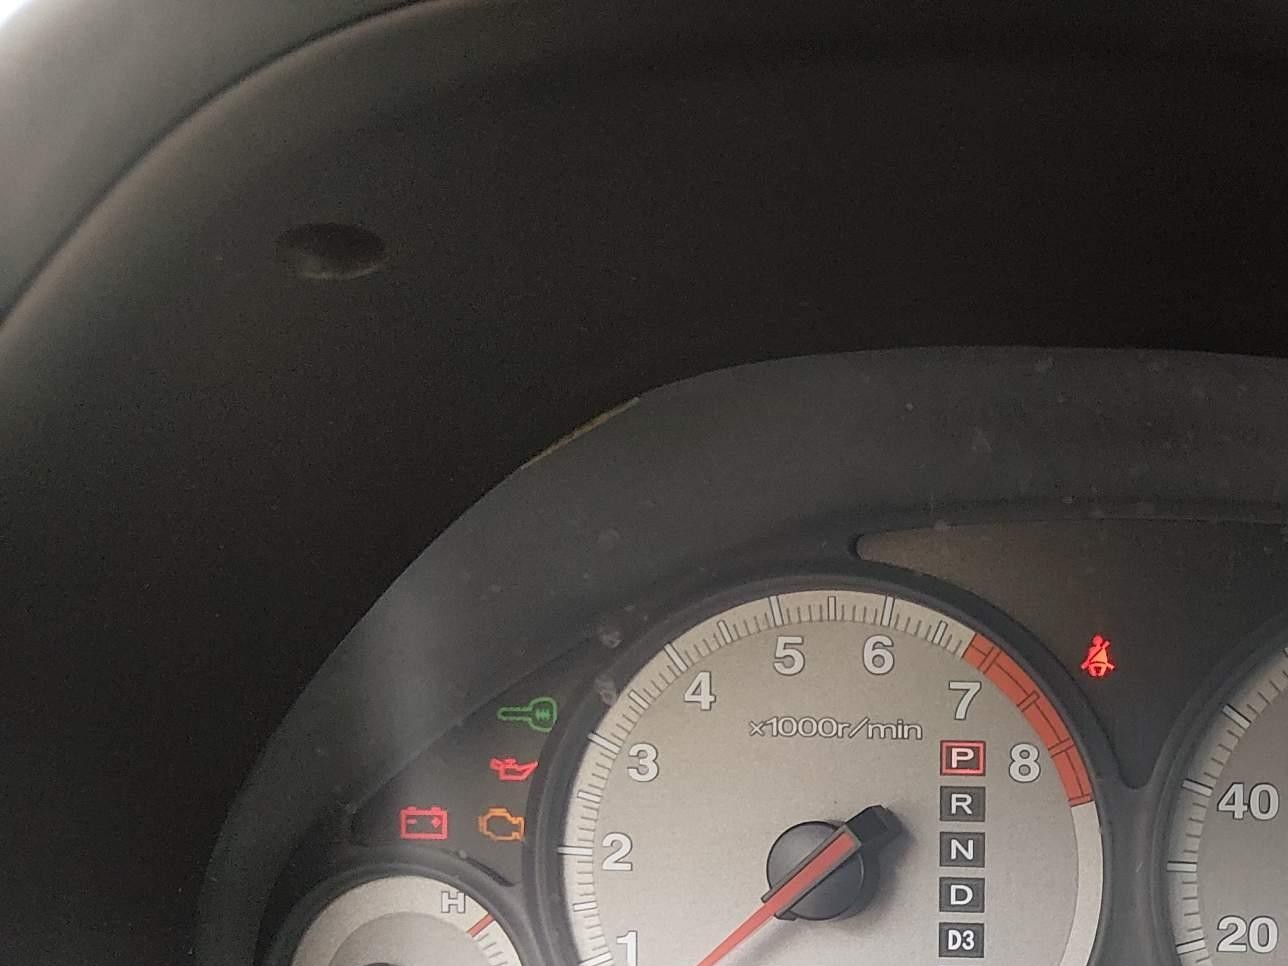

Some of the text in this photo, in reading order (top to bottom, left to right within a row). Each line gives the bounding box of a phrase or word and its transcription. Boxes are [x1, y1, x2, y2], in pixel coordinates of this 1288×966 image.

[773, 636, 805, 675] 5
[862, 635, 895, 674] 6
[684, 672, 716, 710] 4
[948, 681, 982, 720] 7
[749, 718, 923, 741] x1000r/min
[627, 744, 659, 782] 3
[950, 749, 974, 768] P
[1008, 744, 1041, 782] 8
[950, 793, 972, 814] R
[1217, 783, 1280, 820] 40
[602, 833, 633, 871] 2
[950, 839, 974, 859] N
[441, 891, 466, 914] H
[950, 885, 973, 904] D
[948, 930, 975, 950] D3
[1216, 916, 1279, 953] 20
